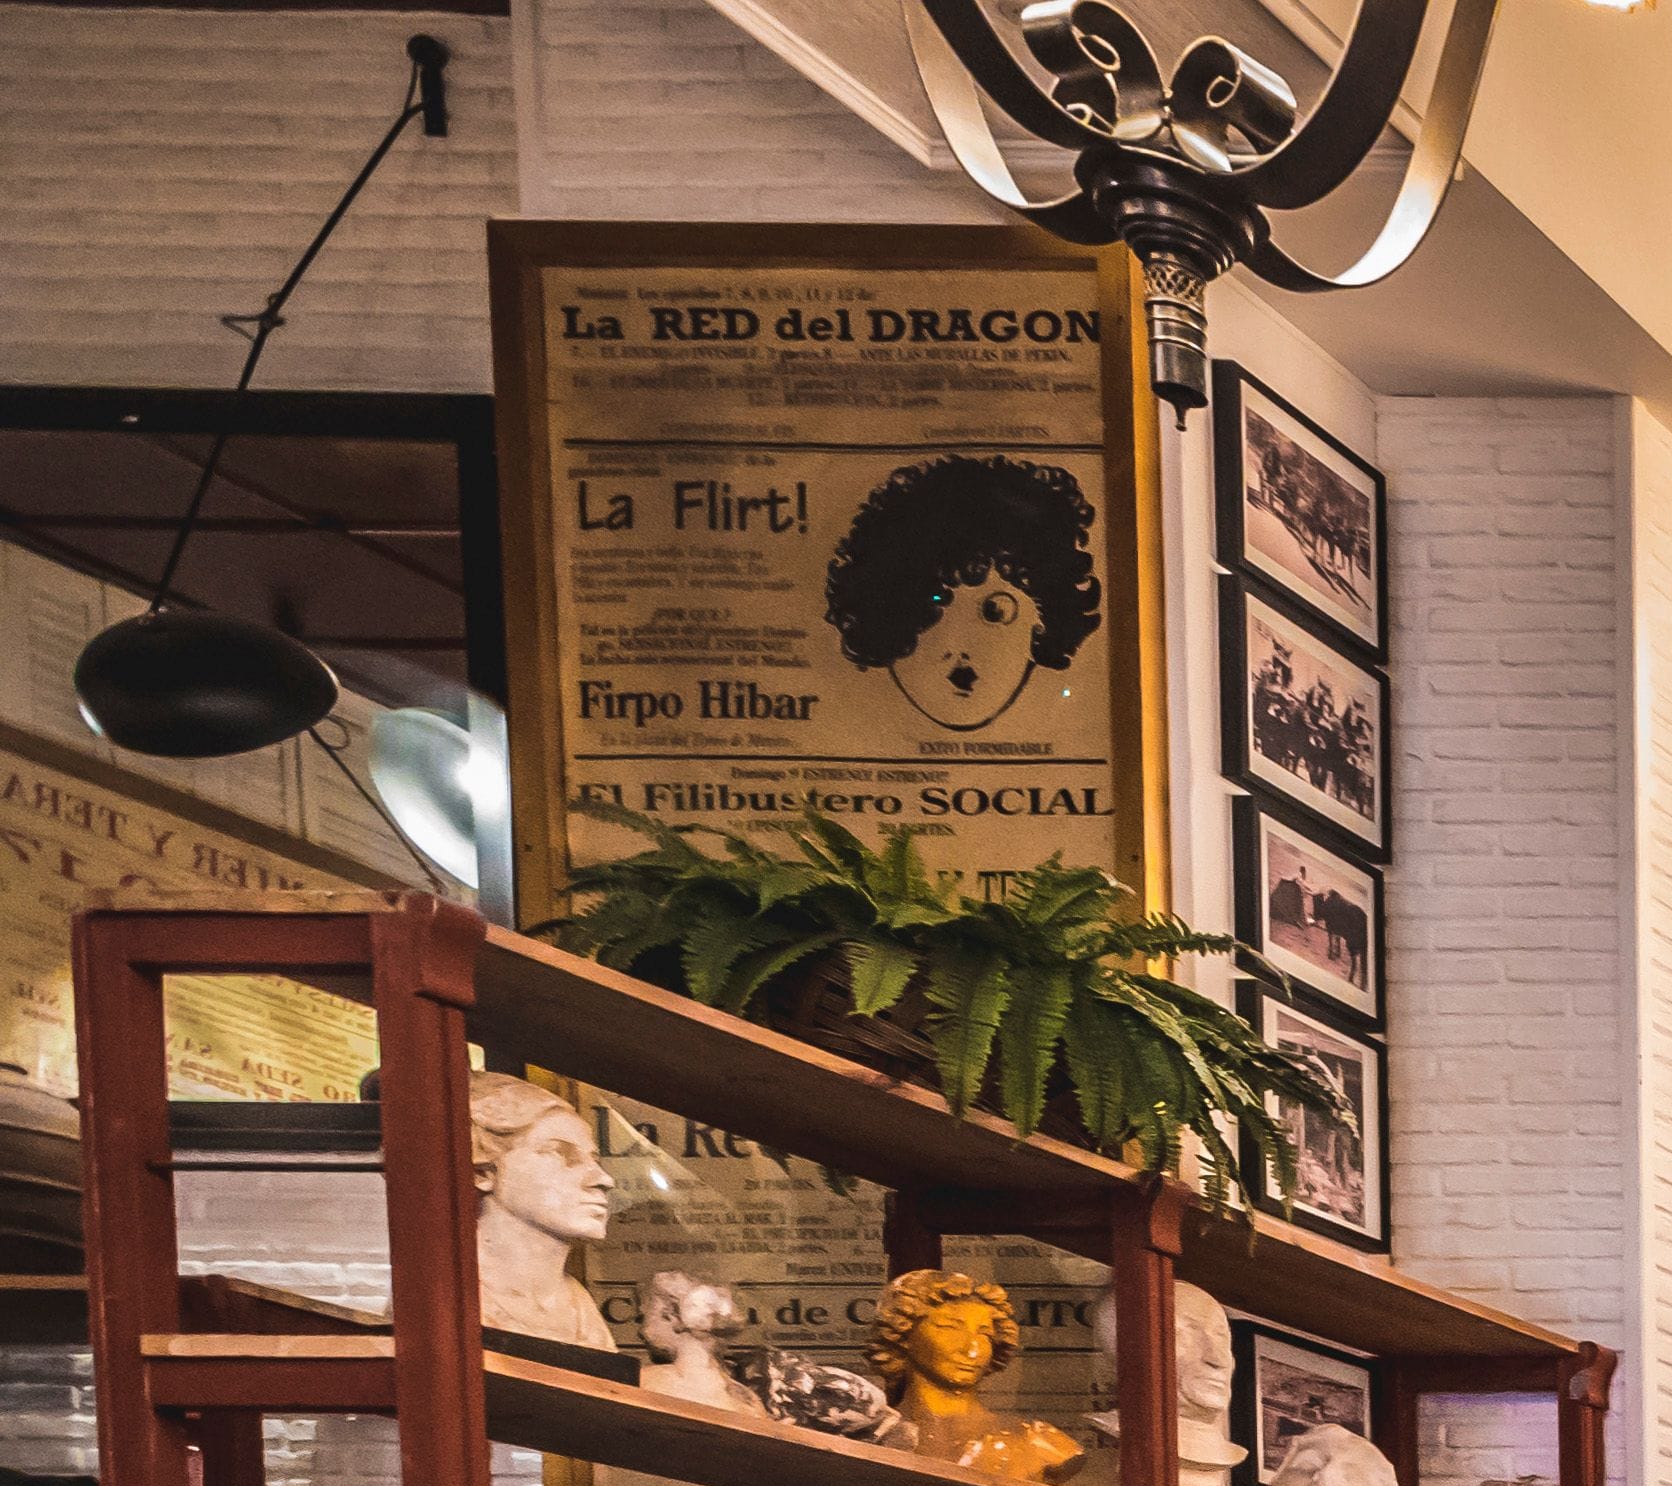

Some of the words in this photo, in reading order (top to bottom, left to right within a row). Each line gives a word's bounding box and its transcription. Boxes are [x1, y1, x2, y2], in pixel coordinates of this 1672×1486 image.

[561, 306, 624, 340] La
[650, 306, 760, 340] RED
[775, 308, 854, 341] del
[865, 309, 1101, 343] DRAGON
[578, 480, 634, 530] La
[674, 480, 808, 533] Flirt!
[578, 680, 684, 727] Firpo
[699, 680, 820, 720] Hibar
[920, 787, 1115, 816] SOCIAL
[775, 1299, 829, 1325] de
